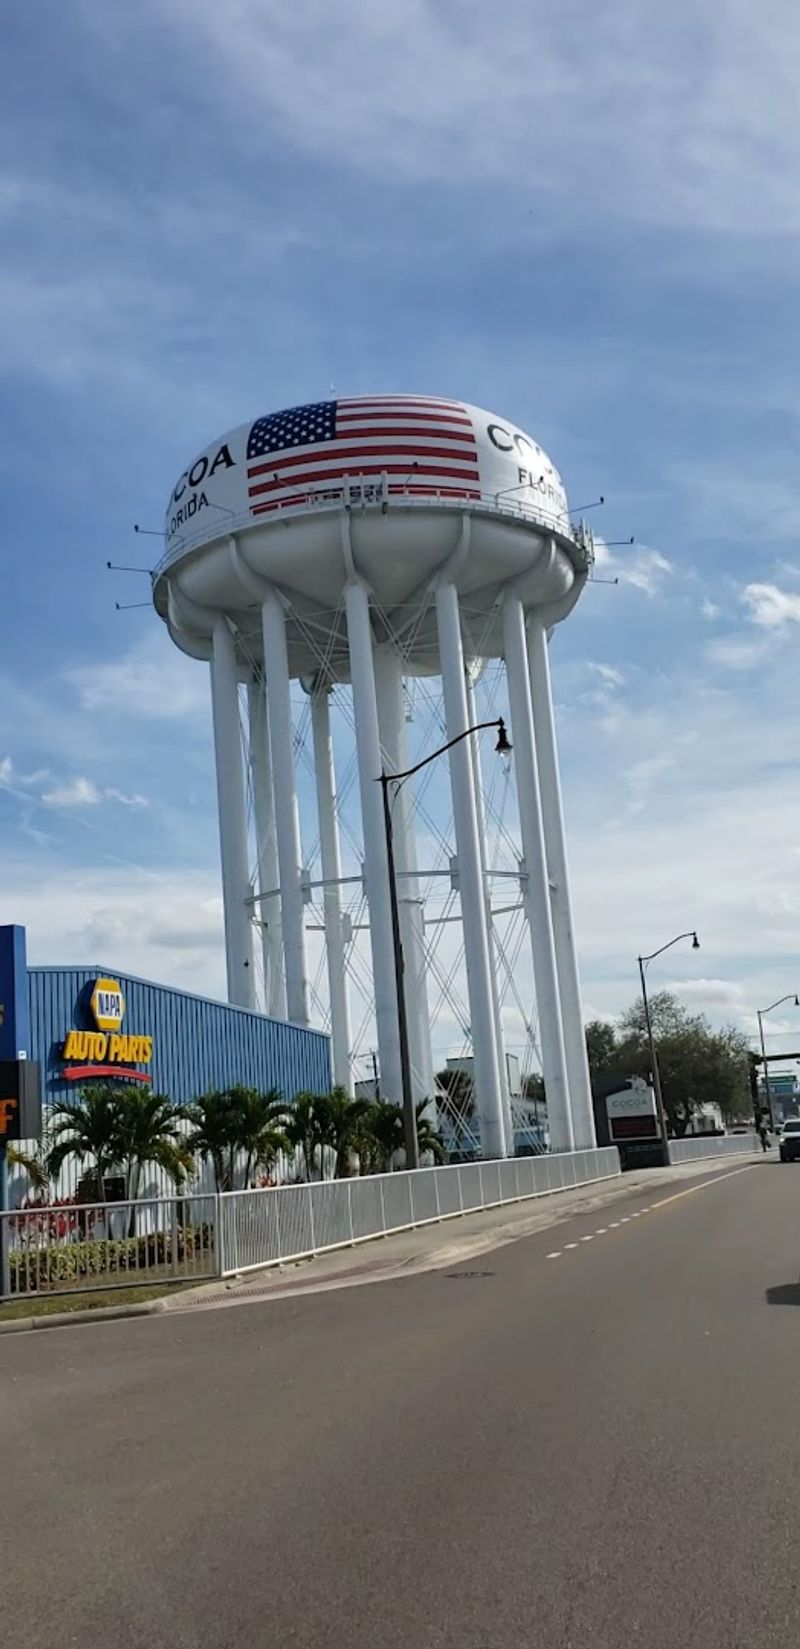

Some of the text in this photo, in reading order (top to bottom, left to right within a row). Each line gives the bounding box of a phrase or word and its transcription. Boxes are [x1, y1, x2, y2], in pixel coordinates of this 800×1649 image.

[171, 443, 237, 503] COA
[169, 492, 210, 538] ORIDA
[97, 992, 121, 1018] NAPA
[63, 1031, 153, 1064] AUTO PARTS
[612, 1097, 648, 1108] COCOA
